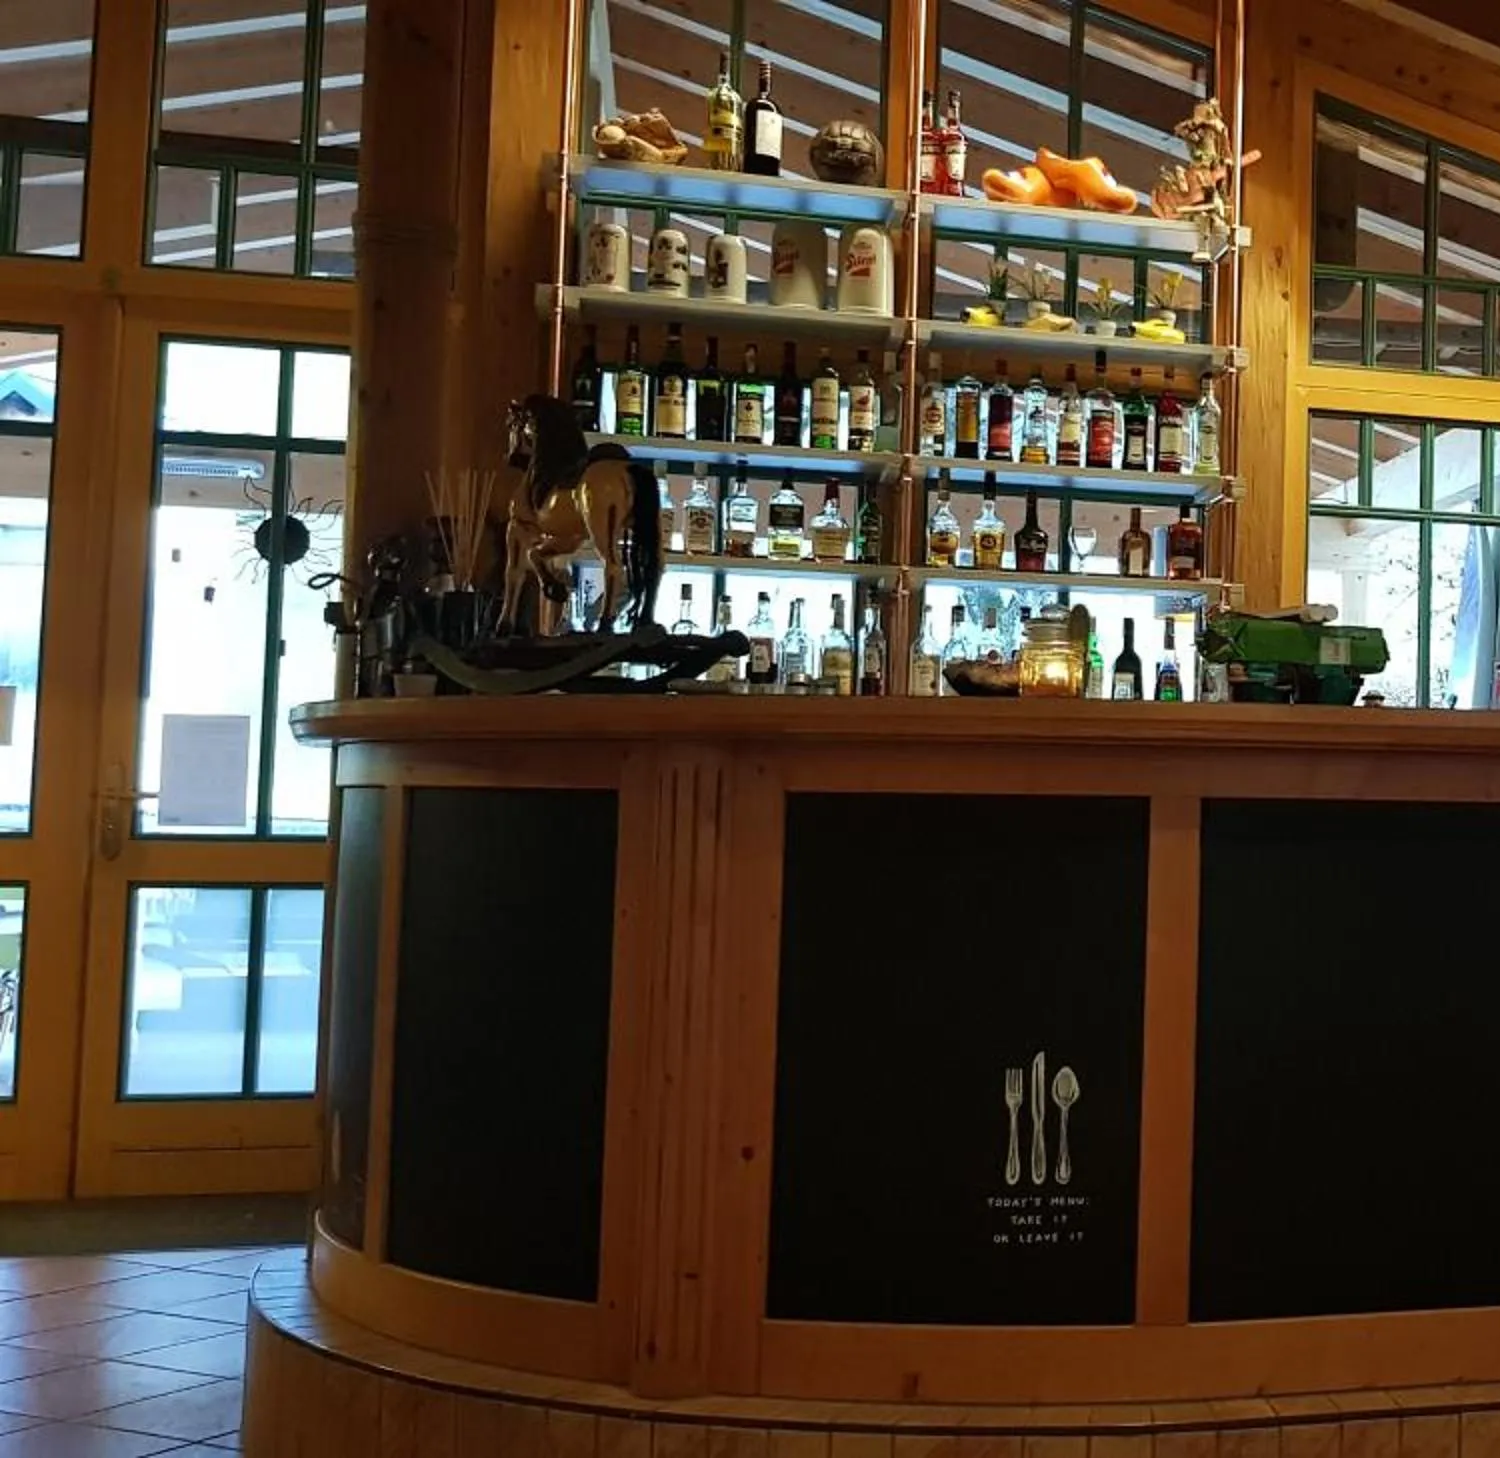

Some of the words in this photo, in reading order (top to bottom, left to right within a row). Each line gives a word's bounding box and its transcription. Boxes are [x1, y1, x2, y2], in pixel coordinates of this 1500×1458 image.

[987, 1195, 1042, 1208] TODAY'S
[1010, 1214, 1042, 1225] TAKE
[1053, 1214, 1068, 1223] IT
[993, 1233, 1009, 1244] OR
[1019, 1231, 1059, 1244] LEAVE
[1069, 1230, 1084, 1241] IT
